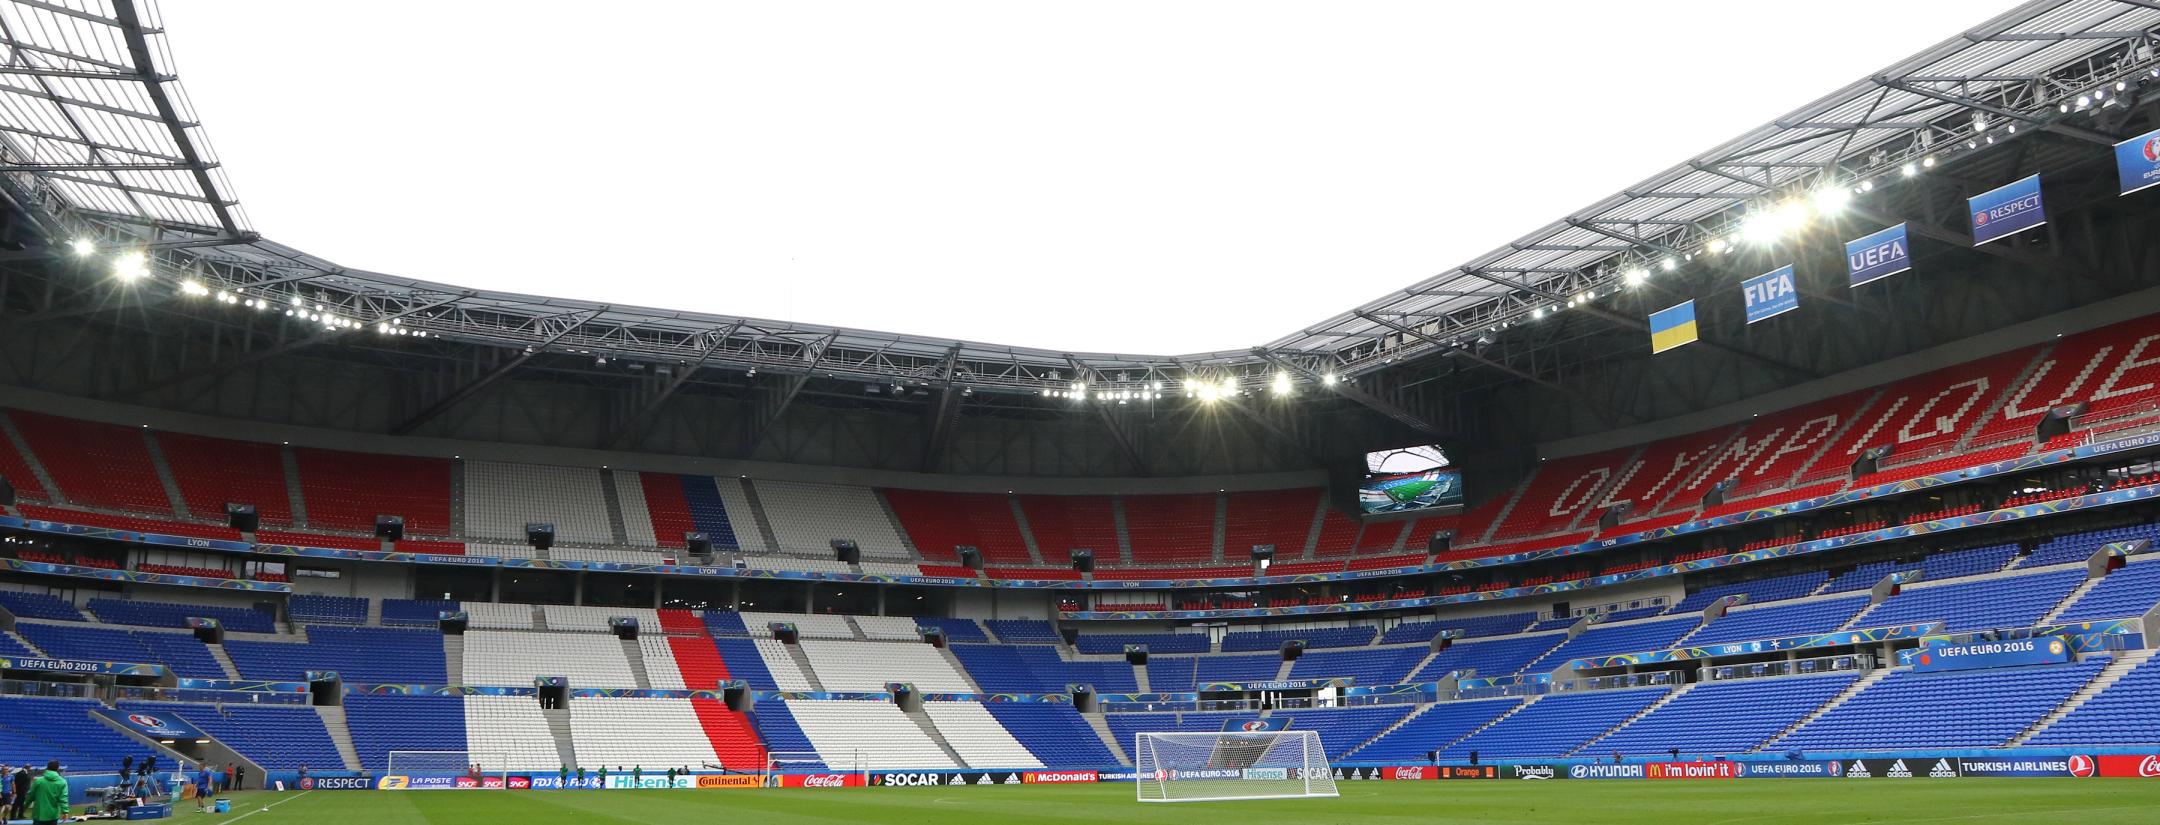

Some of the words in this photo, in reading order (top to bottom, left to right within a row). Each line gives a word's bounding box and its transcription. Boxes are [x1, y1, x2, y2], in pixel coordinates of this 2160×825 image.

[1990, 194, 2040, 220] RESPECT
[1851, 241, 1905, 271] UEFA
[1743, 274, 1794, 307] FIFA
[2093, 442, 2118, 453] UEFA
[2119, 437, 2145, 448] EURO
[187, 538, 210, 547] LYON
[1601, 538, 1617, 547] LYON
[698, 567, 717, 575] LYON
[1723, 645, 1742, 653] LYON
[1939, 646, 1969, 657] UEFA
[1970, 644, 2002, 655] EURO
[2004, 641, 2034, 653] 2016
[20, 659, 46, 669] UEFA
[47, 660, 73, 670] EURO
[75, 662, 98, 671] 2016
[1514, 765, 1554, 778] Probably
[1589, 765, 1643, 777] HYUNDAI
[1665, 764, 1683, 776] i'm
[1720, 764, 1729, 776] it
[1751, 765, 1774, 774] UEFA
[1775, 764, 1798, 773] EURO
[1799, 764, 1822, 773] 2016
[1962, 762, 2012, 772] TURKISH
[2013, 761, 2068, 771] AIRLINES
[1037, 773, 1096, 783] McDonald's
[1180, 770, 1200, 778] UEFA
[1201, 769, 1221, 778] EURO
[1456, 767, 1480, 778] Orange
[318, 778, 371, 789] RESPECT
[457, 780, 478, 788] SNCF
[483, 780, 503, 788] SNCF
[508, 780, 529, 788] SNCF
[532, 778, 552, 787] FDJ
[699, 775, 750, 786] Continental
[885, 773, 939, 786] SOCAR
